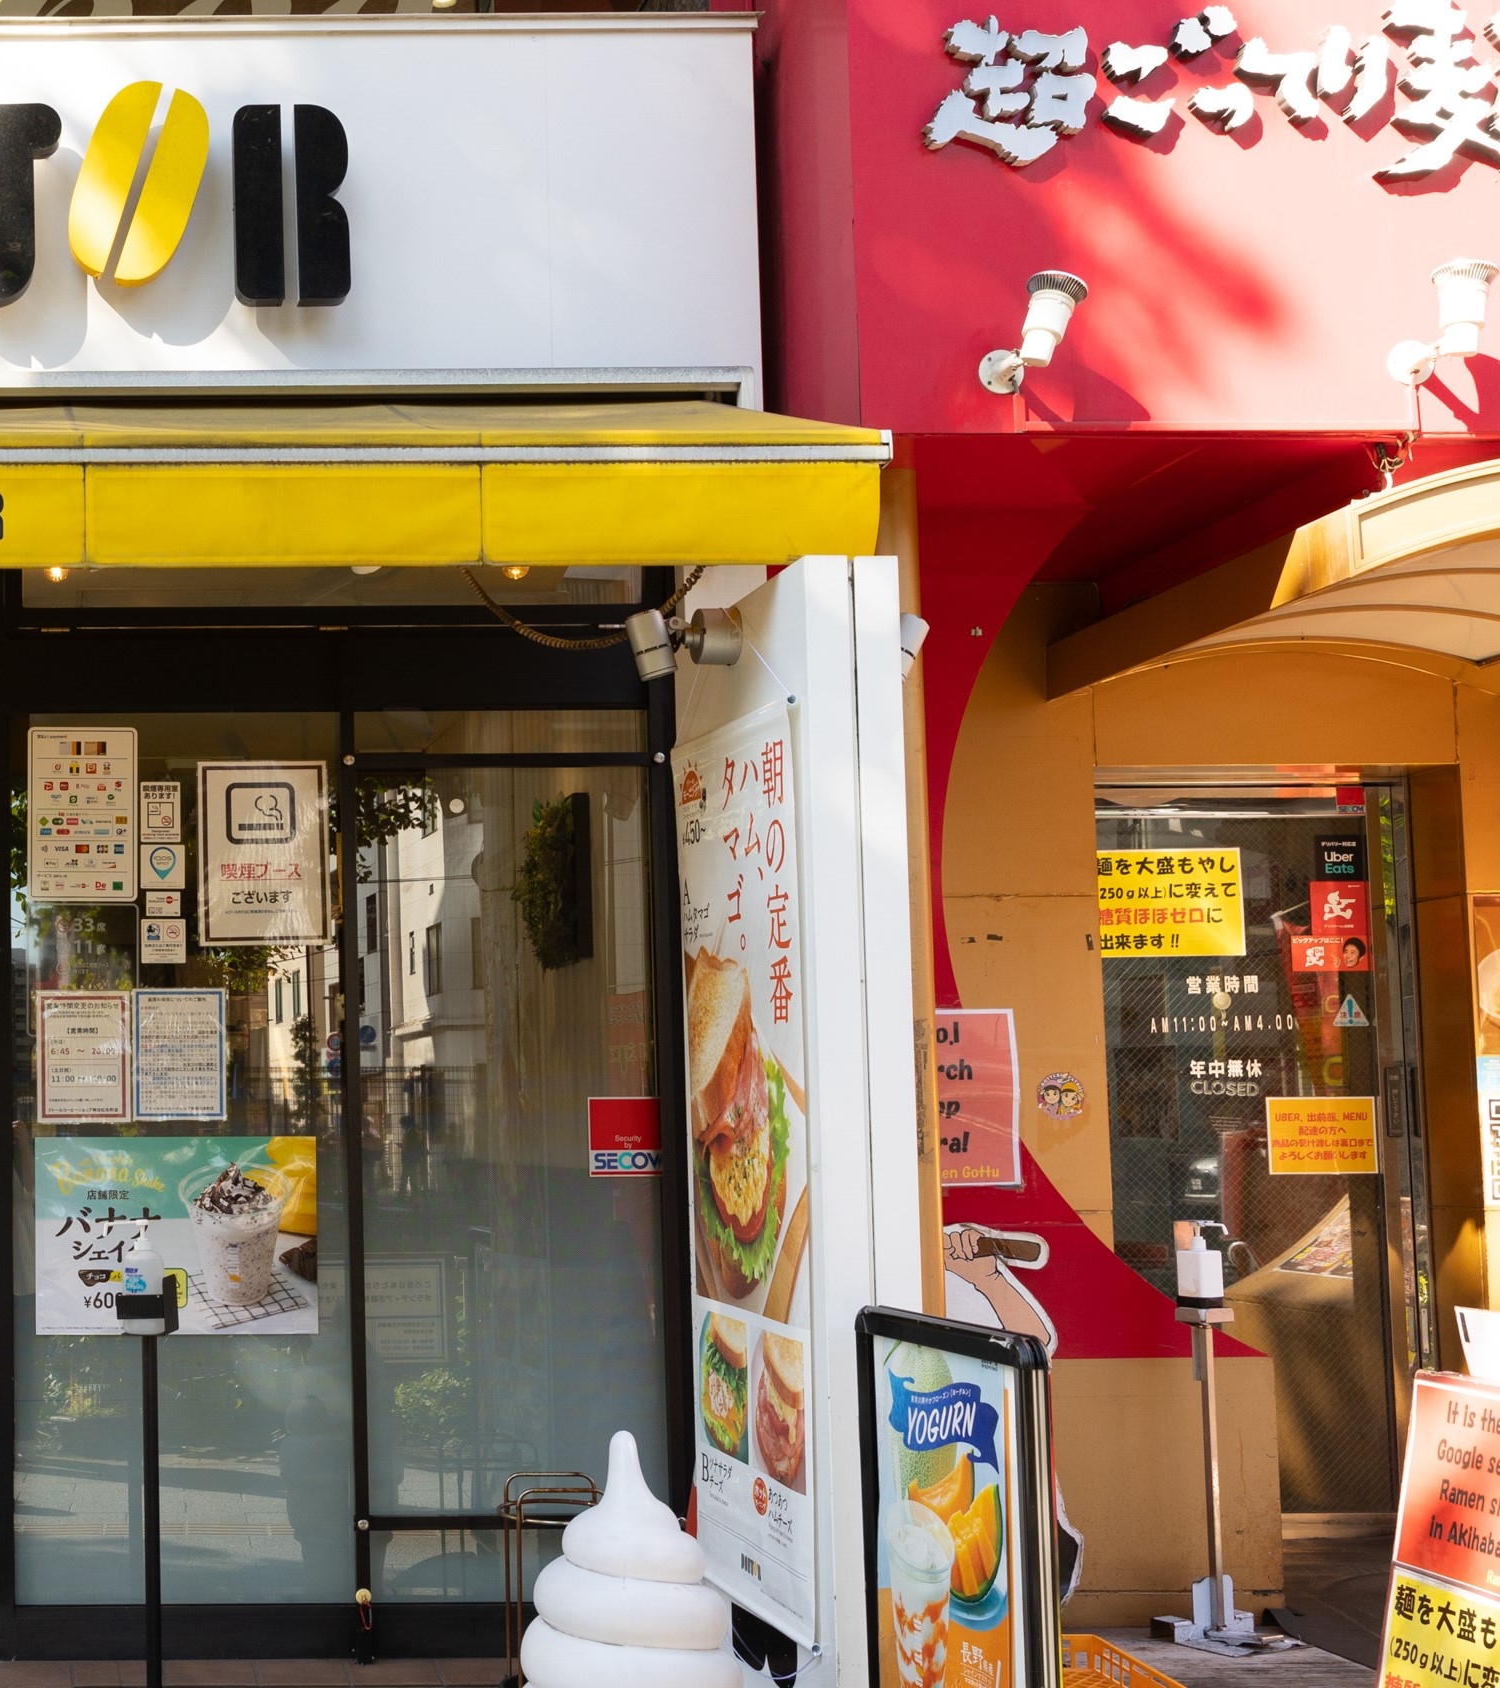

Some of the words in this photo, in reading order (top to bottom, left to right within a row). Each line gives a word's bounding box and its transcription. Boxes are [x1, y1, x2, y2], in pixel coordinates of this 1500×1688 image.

[143, 785, 178, 793] 喫煙専用室
[1324, 851, 1354, 863] Uber
[221, 861, 302, 879] 喫煙ブース
[1325, 863, 1355, 875] Eats
[761, 739, 794, 1025] 朝の定番
[232, 890, 293, 905] ございます
[683, 878, 691, 906] A
[1186, 975, 1259, 995] 営業時間
[50, 1047, 70, 1055] 6:45
[1189, 1059, 1263, 1078] 年中無休
[51, 1075, 75, 1083] 11:00
[1190, 1080, 1260, 1097] CLOSED
[615, 1134, 642, 1144] Security
[1298, 1126, 1347, 1136] 配達の方へ
[623, 1141, 632, 1150] by
[1279, 1150, 1369, 1161] よろしくお願いします
[87, 1189, 130, 1201] 店舗限定
[55, 1206, 162, 1241] バナナ
[72, 1240, 136, 1263] シェイ
[86, 1272, 107, 1280] チョコ
[83, 1292, 123, 1309] ¥60
[907, 1400, 977, 1446] YOGURN
[1446, 1400, 1458, 1425] It
[1463, 1404, 1476, 1429] is
[1437, 1438, 1484, 1471] Google
[702, 1452, 710, 1483] B
[709, 1475, 724, 1495] チーズ
[1439, 1478, 1485, 1512] Ramen
[1429, 1514, 1444, 1541] in
[1394, 1583, 1498, 1650] 麺を大盛も
